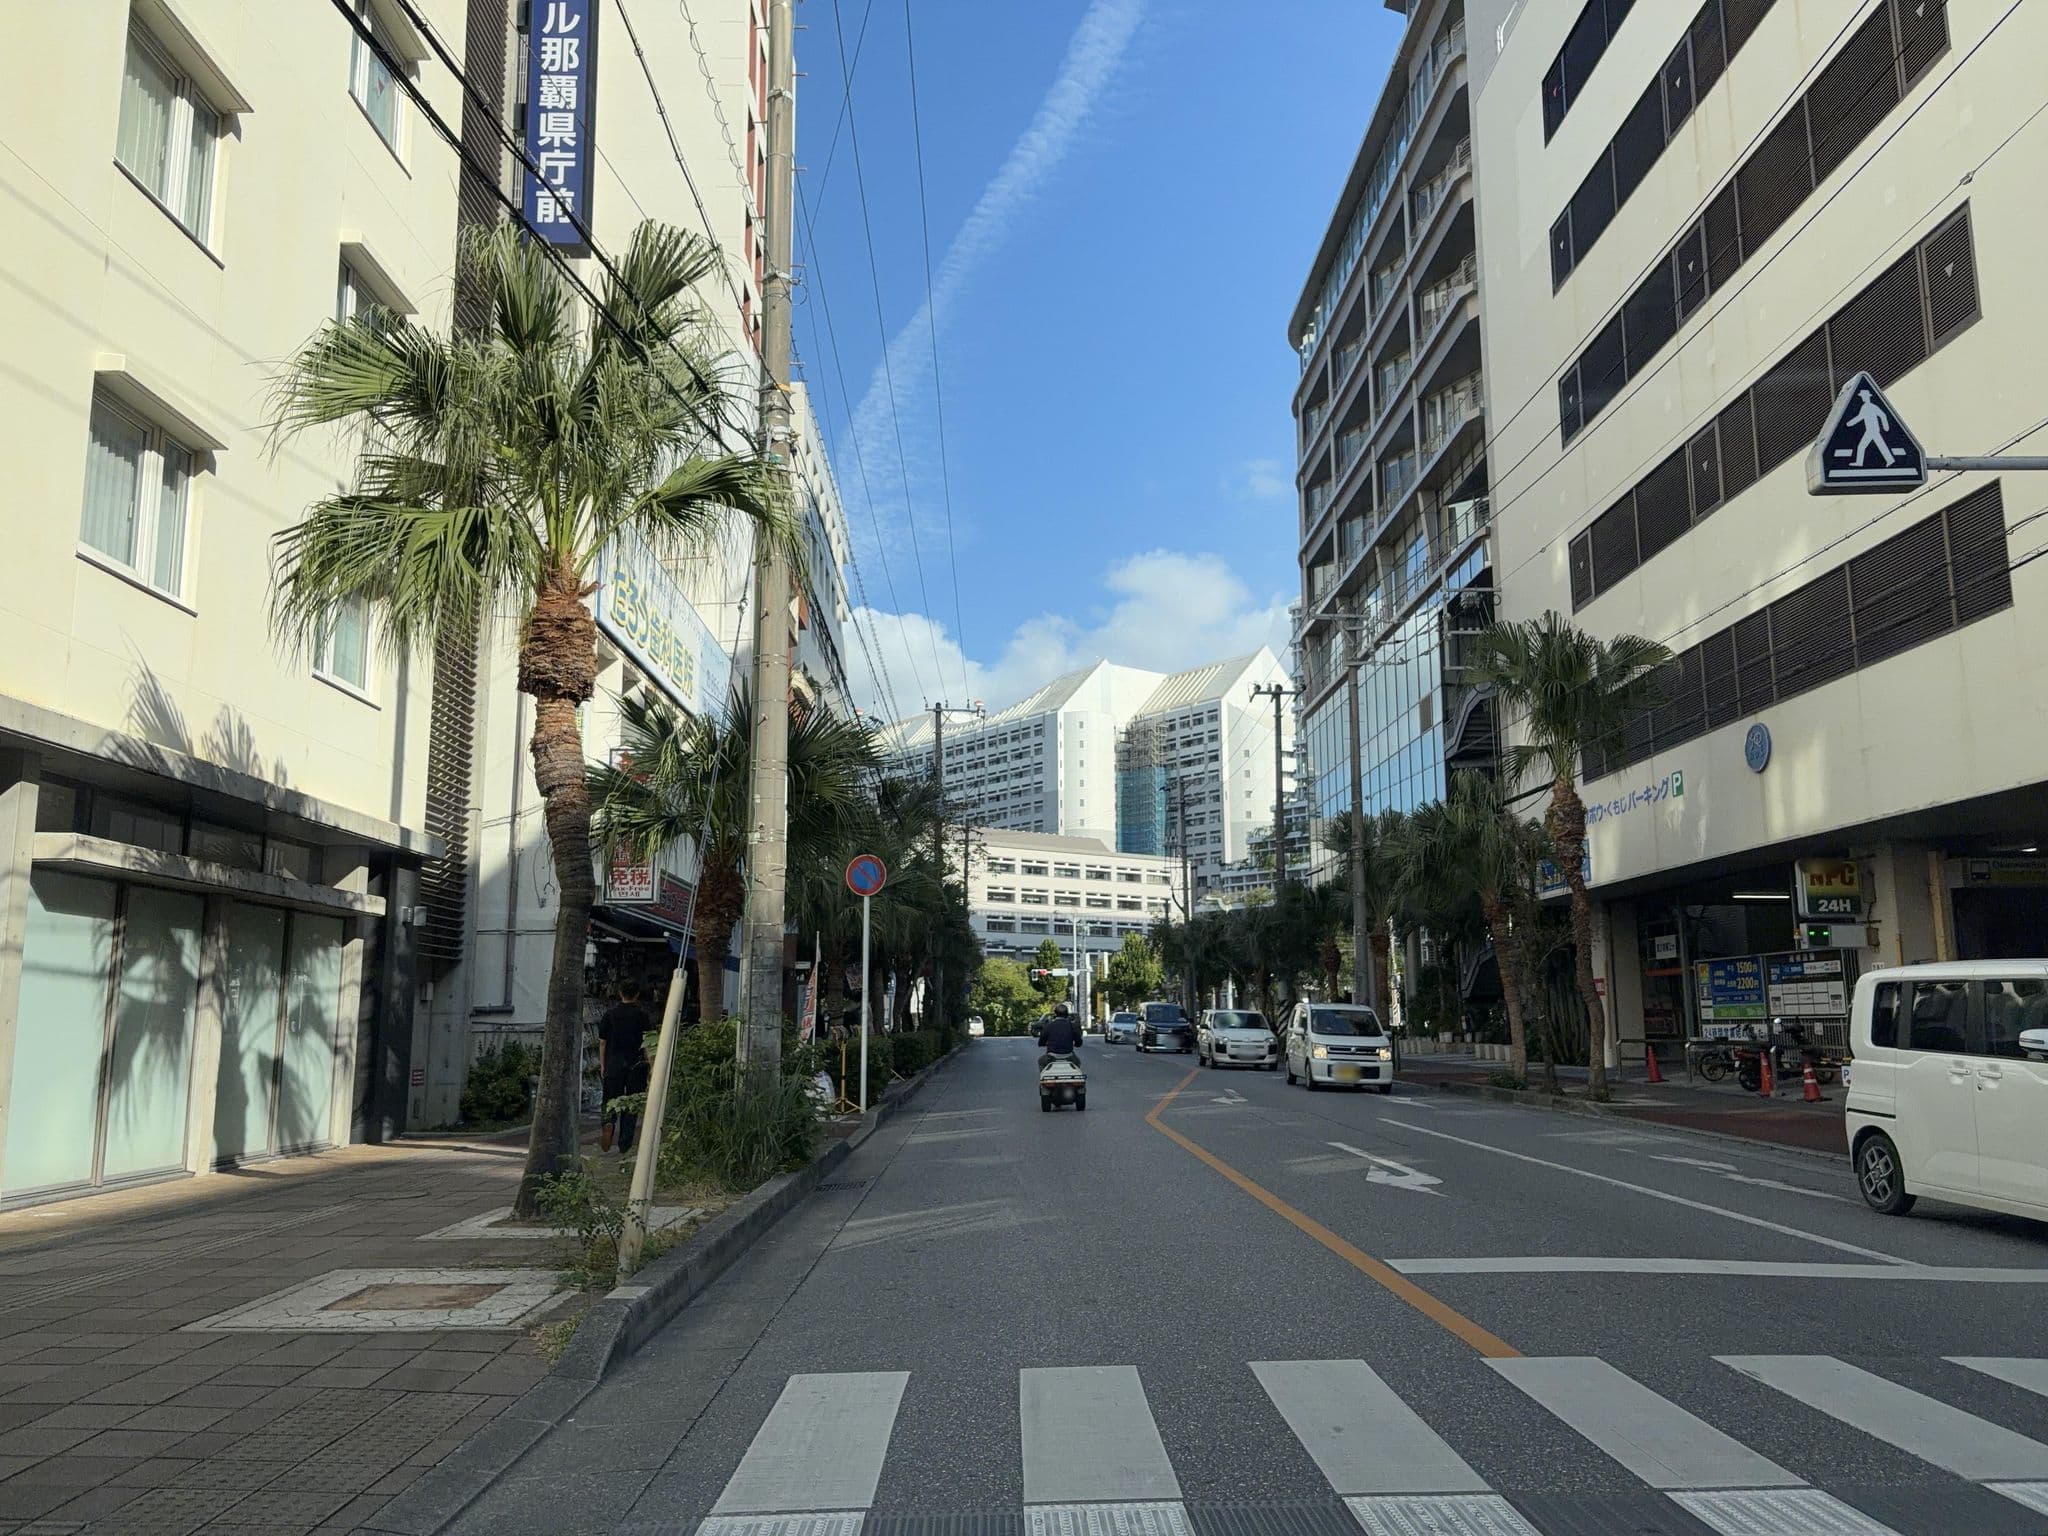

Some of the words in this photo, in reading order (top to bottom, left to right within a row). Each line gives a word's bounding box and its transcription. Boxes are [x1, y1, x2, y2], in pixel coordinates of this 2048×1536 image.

[536, 2, 580, 223] ル那覇県庁前
[1818, 898, 1851, 913] 24H
